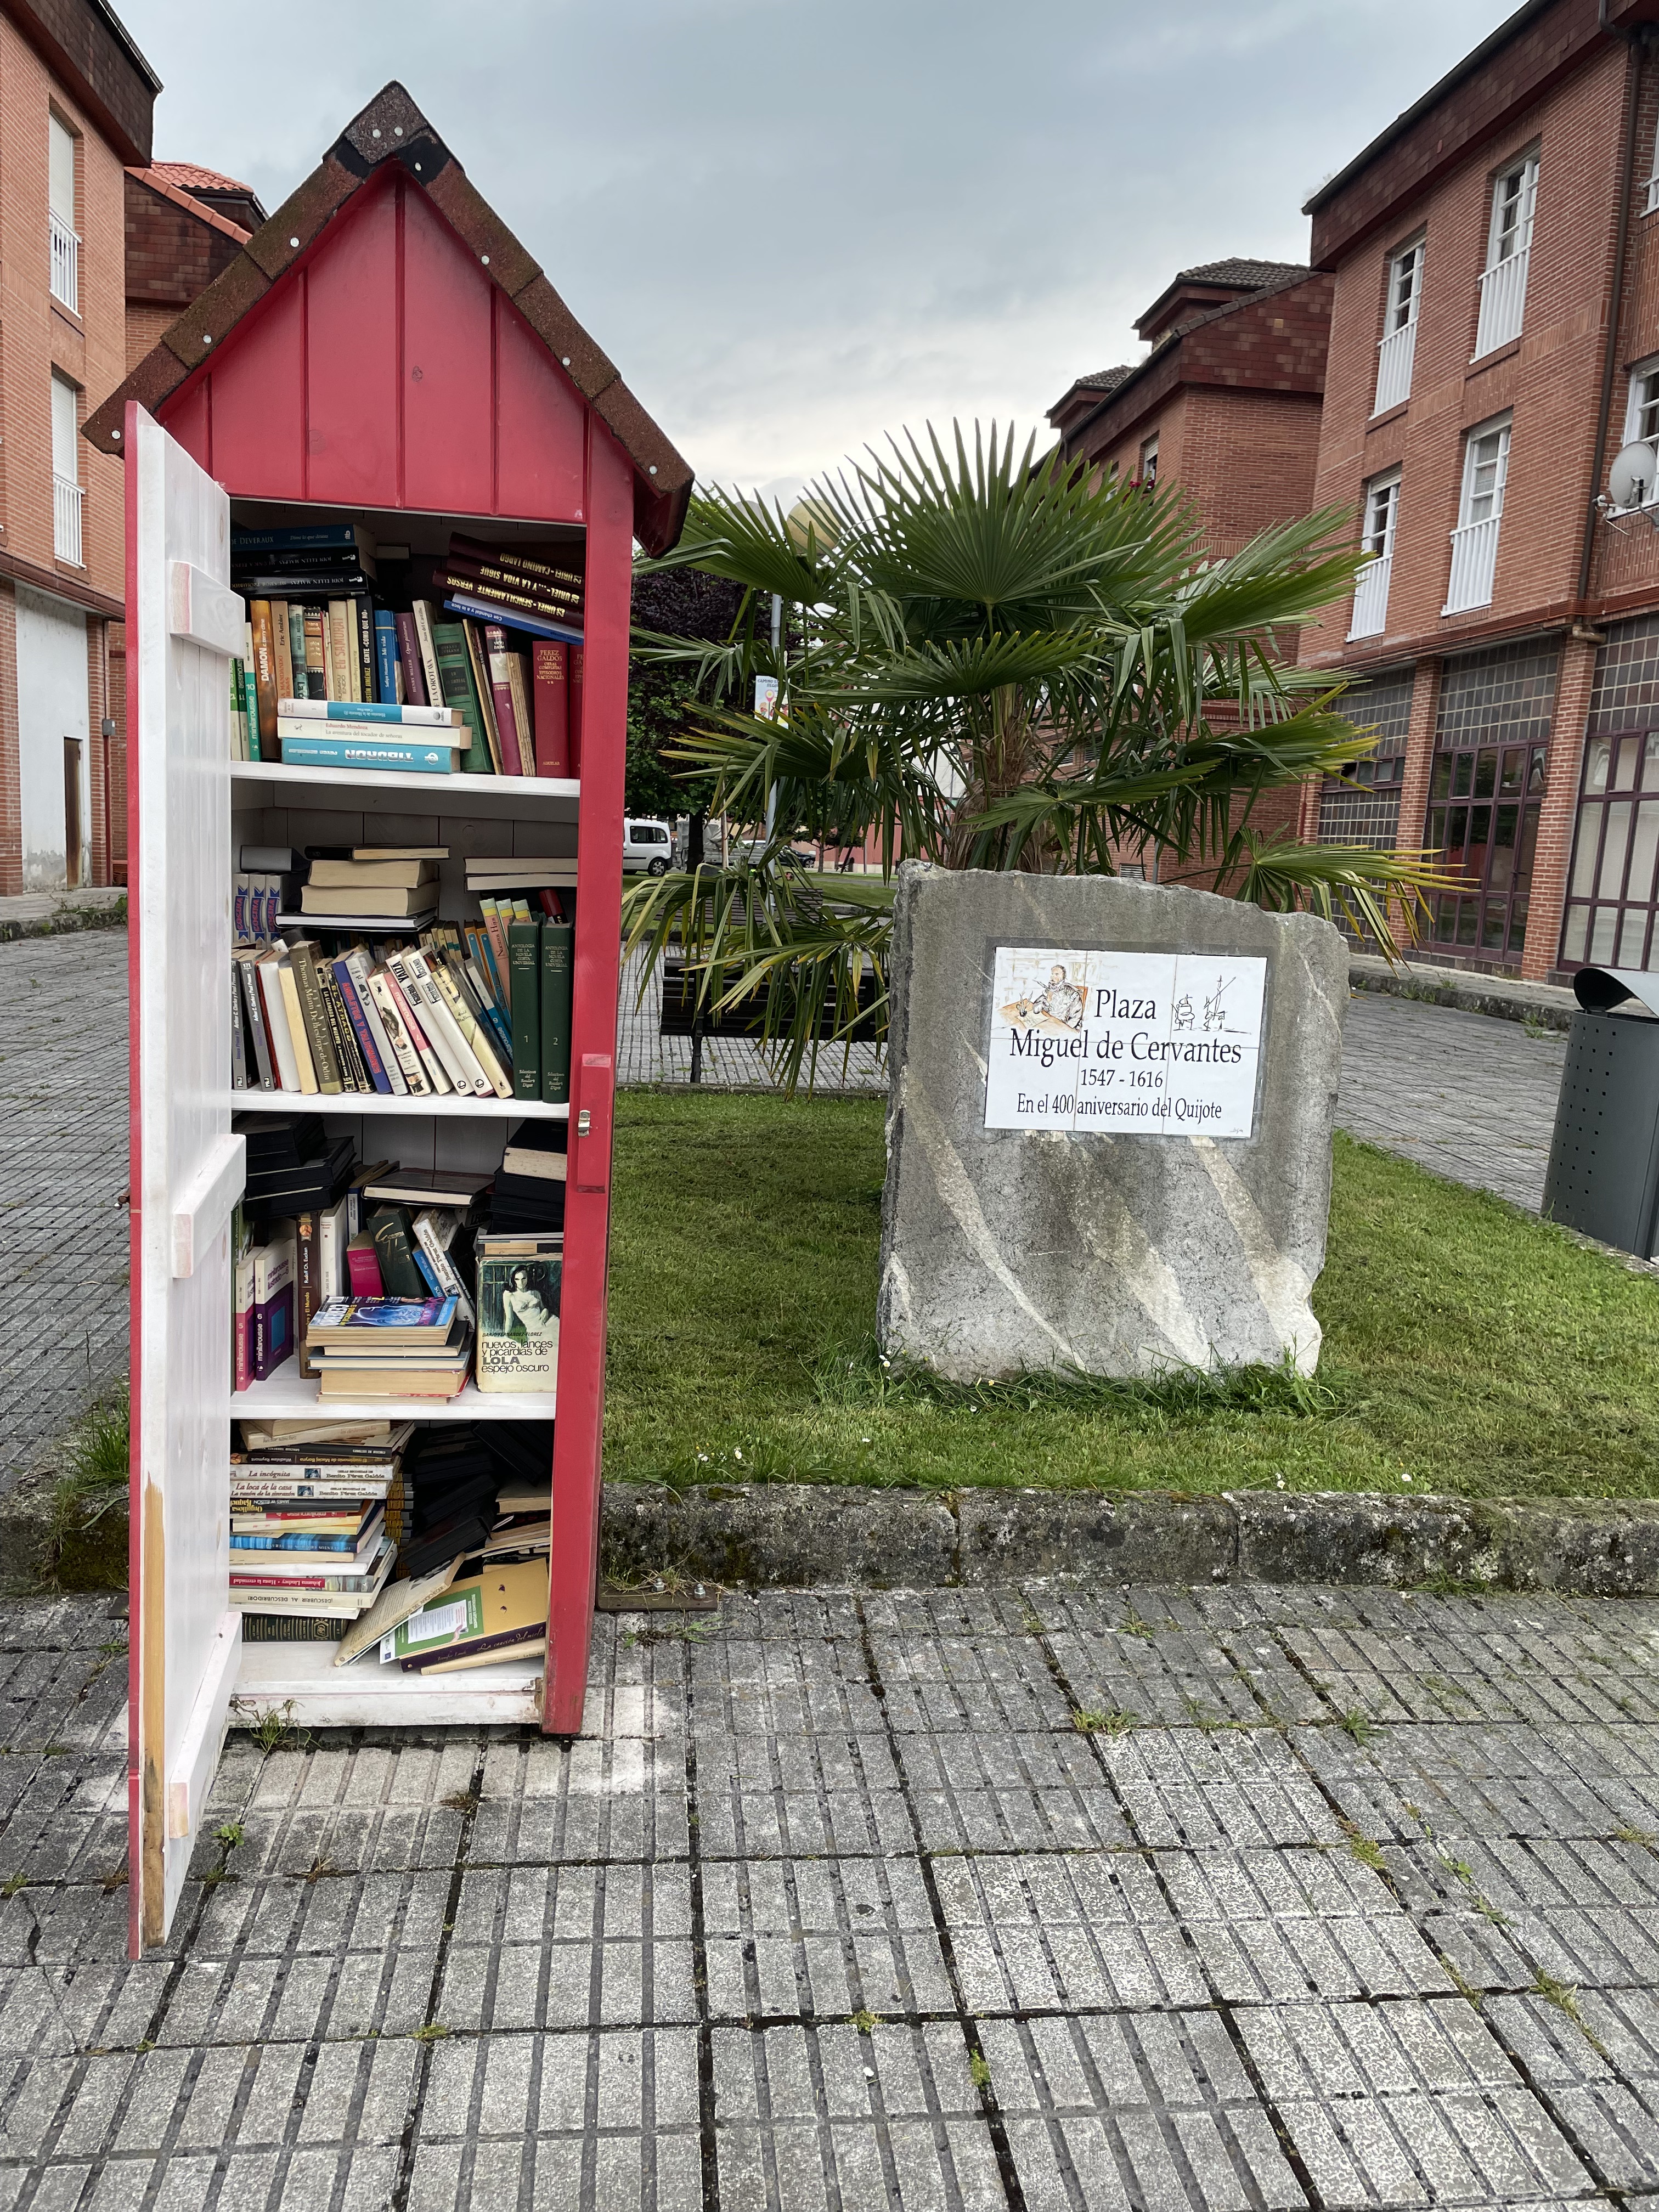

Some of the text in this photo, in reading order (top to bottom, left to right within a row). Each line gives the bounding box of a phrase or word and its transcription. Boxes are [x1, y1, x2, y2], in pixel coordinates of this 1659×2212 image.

[240, 536, 274, 545] DEVERAUX
[500, 553, 521, 566] LARGO
[479, 566, 501, 579] SIGUE
[503, 573, 520, 585] VIDA
[447, 576, 473, 591] VERSOS
[522, 579, 531, 588] LA
[475, 609, 493, 618] chandal
[332, 618, 346, 669] EL SAMURAI
[381, 647, 387, 656] Mi
[259, 647, 269, 681] DAMON
[427, 658, 438, 690] OROTAVA
[297, 681, 305, 691] La
[432, 691, 439, 703] LA
[249, 696, 257, 740] minilarousse
[345, 749, 414, 763] TIBURON
[491, 917, 505, 957] Nuestros Hijos
[392, 961, 409, 983] YAIZA
[407, 983, 422, 1006] FIGUEROA
[426, 981, 441, 1004] FIGUEROA
[331, 985, 352, 1041] EL ATRACO
[394, 992, 416, 1030] minilarousse
[1094, 989, 1156, 1019] Plaza
[298, 958, 309, 988] Thomas
[304, 989, 314, 1011] Mann
[310, 1011, 317, 1022] De
[320, 1062, 330, 1080] Odín
[325, 997, 334, 1017] LLAMADA
[332, 1026, 341, 1043] MUERTO
[342, 982, 362, 1020] AMULETOS
[359, 1029, 382, 1074] TALISMANES
[1009, 1028, 1242, 1068] Miguel de Cervantes
[1081, 1069, 1116, 1086] 1547
[1129, 1070, 1164, 1087] 1616
[1017, 1093, 1222, 1125] En el 400 aniversario del Quijote
[441, 1263, 452, 1282] Benito
[318, 1304, 350, 1325] CEREBRO
[521, 1339, 553, 1348] lances
[535, 1345, 548, 1355] de
[482, 1365, 514, 1375] espejo
[483, 1356, 520, 1365] LOLA
[259, 1470, 290, 1479] incógnita
[392, 1609, 412, 1624] DIALOGOS
[420, 1585, 444, 1603] ANOCHECER
[476, 1643, 492, 1651] La
[516, 1632, 527, 1644] del
